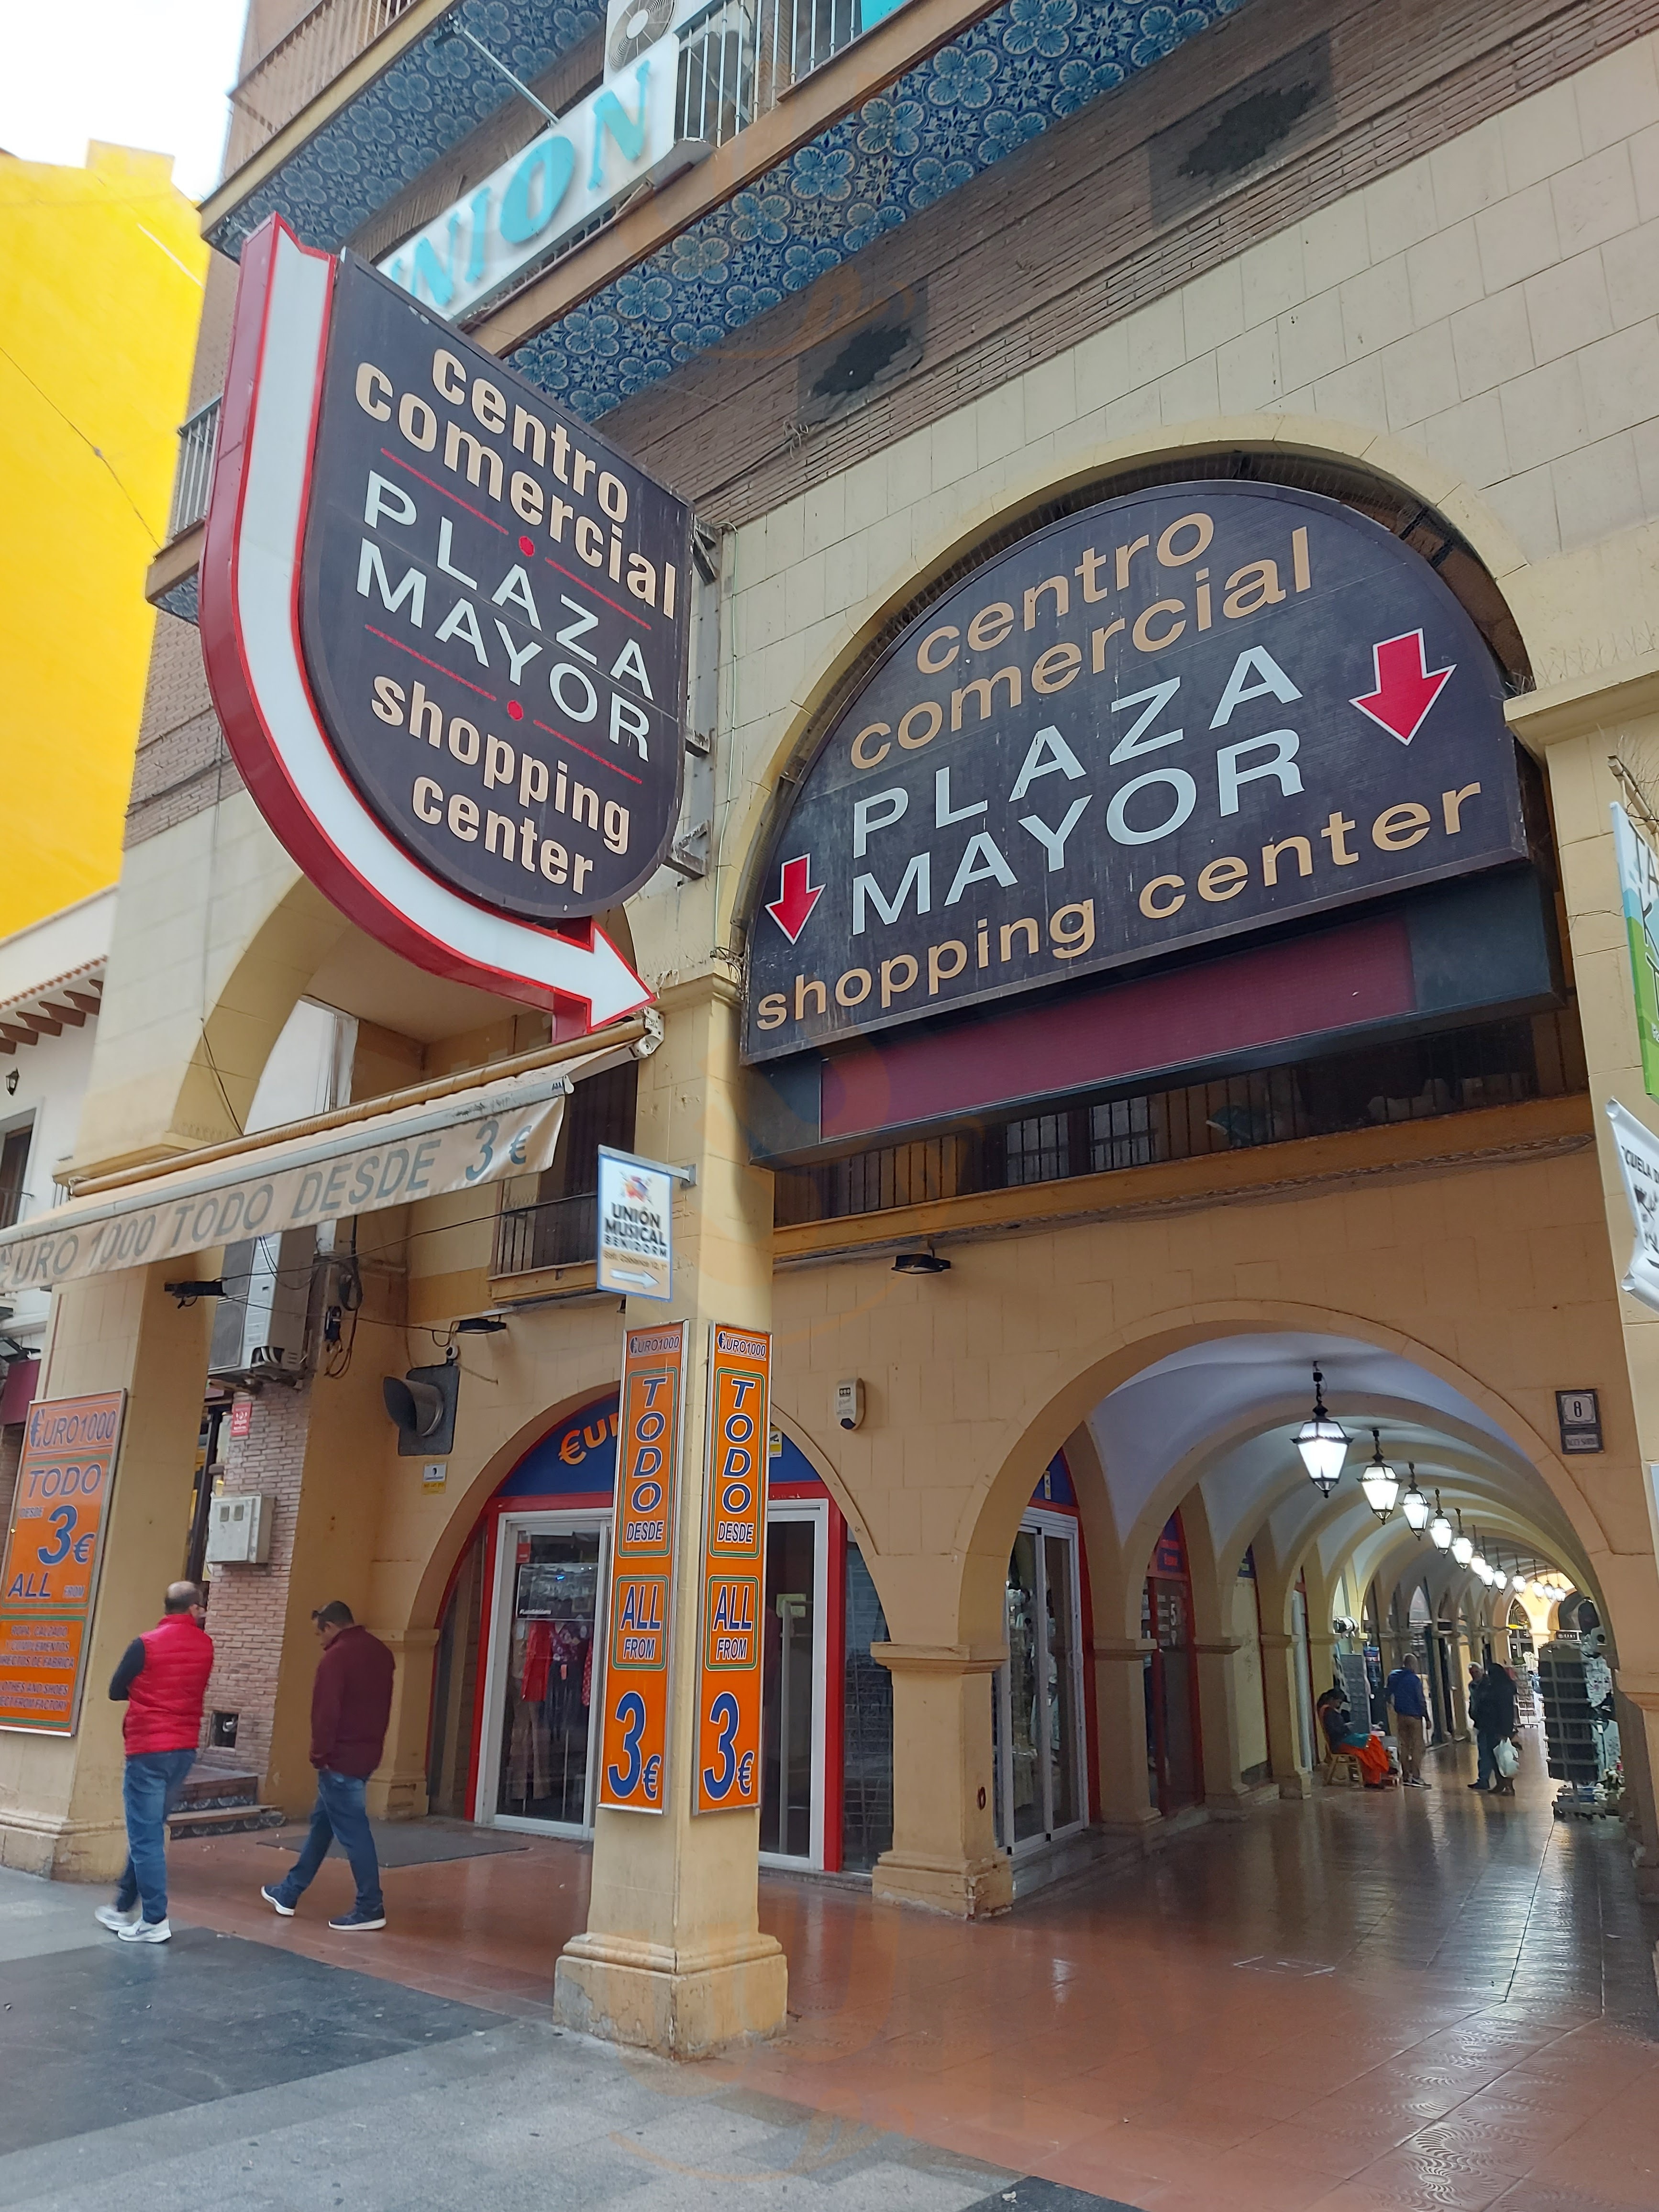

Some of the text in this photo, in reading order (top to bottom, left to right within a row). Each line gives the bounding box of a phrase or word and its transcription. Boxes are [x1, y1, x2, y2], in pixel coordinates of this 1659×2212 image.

[355, 362, 676, 620] comercial
[432, 348, 628, 523] centro
[356, 537, 649, 763] MAYOR
[363, 470, 654, 701] PLAZA
[850, 526, 1314, 770] comercial
[917, 511, 1216, 675] centro
[371, 675, 630, 855] shopping
[853, 645, 1302, 860] PLAZA
[412, 776, 594, 895] center
[852, 728, 1305, 936] MAYOR
[756, 782, 1482, 1030] shopping center
[90, 1213, 156, 1267] 1000
[170, 1183, 275, 1249] TODO
[290, 1138, 441, 1219] DESDE
[605, 1218, 667, 1247] MUSICAL
[610, 1202, 661, 1229] UNIÓN
[632, 1377, 668, 1513] TODO
[722, 1378, 755, 1514] TODO
[1573, 1401, 1582, 1417] 8
[28, 1464, 102, 1499] TODO
[626, 1520, 664, 1543] DESDE
[717, 1521, 754, 1544] DESDE
[8, 1572, 51, 1598] ALL
[619, 1585, 661, 1631] ALL
[623, 1637, 656, 1660] FROM
[712, 1585, 752, 1632] ALL
[716, 1638, 748, 1661] FROM
